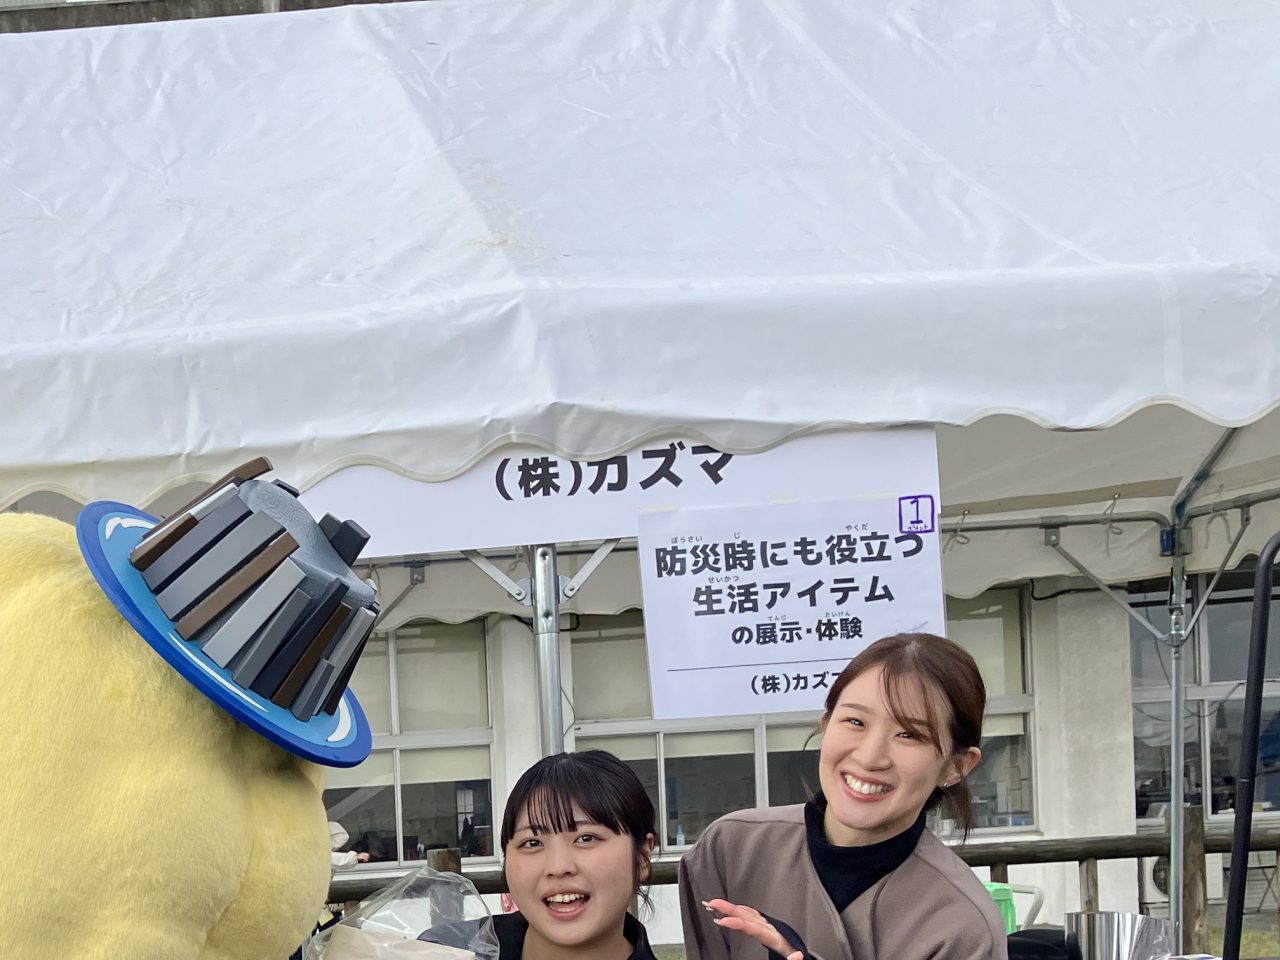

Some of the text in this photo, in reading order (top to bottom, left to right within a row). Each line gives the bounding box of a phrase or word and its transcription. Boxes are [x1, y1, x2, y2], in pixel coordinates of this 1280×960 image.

[495, 441, 734, 501] (株)カズマ
[910, 497, 924, 524] 1
[671, 535, 703, 544] ぼうさい
[845, 523, 869, 532] やくだ
[655, 531, 924, 578] 防災時にも役立つ
[708, 575, 740, 584] せいかつ
[693, 575, 895, 617] 生活アイテム
[731, 616, 864, 645] の展示・体験
